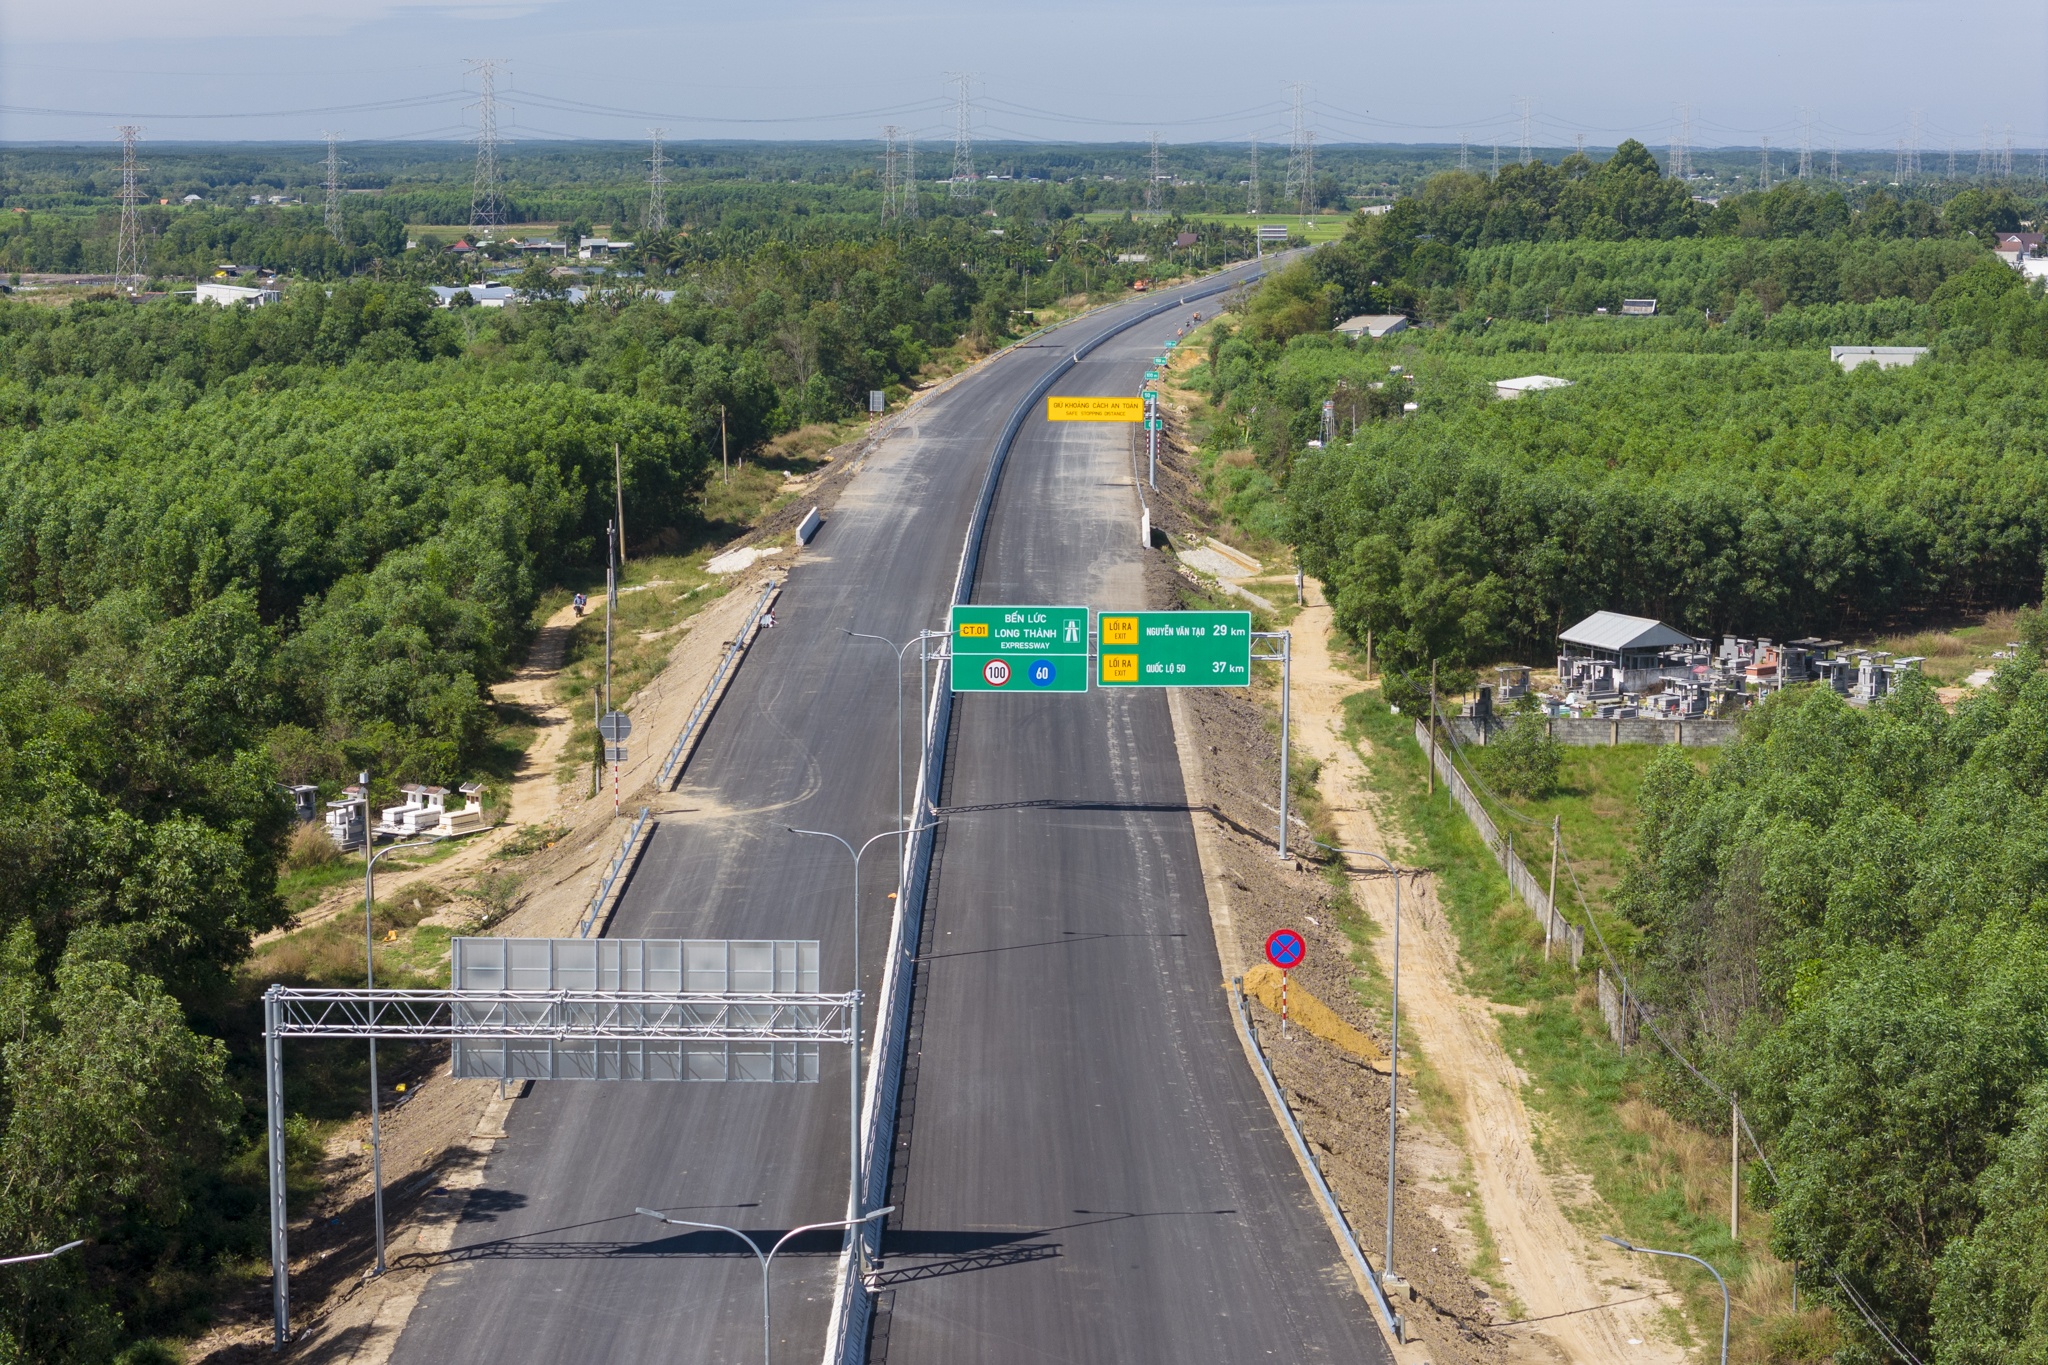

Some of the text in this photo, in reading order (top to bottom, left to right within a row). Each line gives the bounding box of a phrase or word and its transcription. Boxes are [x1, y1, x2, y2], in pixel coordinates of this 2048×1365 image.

[1092, 401, 1109, 409] CÁCH
[1123, 401, 1139, 409] TOÀN
[1004, 610, 1047, 623] BẾN LỨC
[963, 626, 986, 635] CT.01
[1108, 619, 1132, 631] LỐI RA
[1146, 624, 1205, 637] NGUYỄN VĂN TẠO
[1212, 624, 1246, 636] 29 km
[994, 627, 1057, 638] LONG THÀNH
[1108, 657, 1132, 668] LỐI RA
[1145, 661, 1186, 675] QUỐC LỘ 50
[1211, 661, 1244, 673] 37 km
[988, 666, 1006, 679] 100
[1035, 667, 1049, 679] 60
